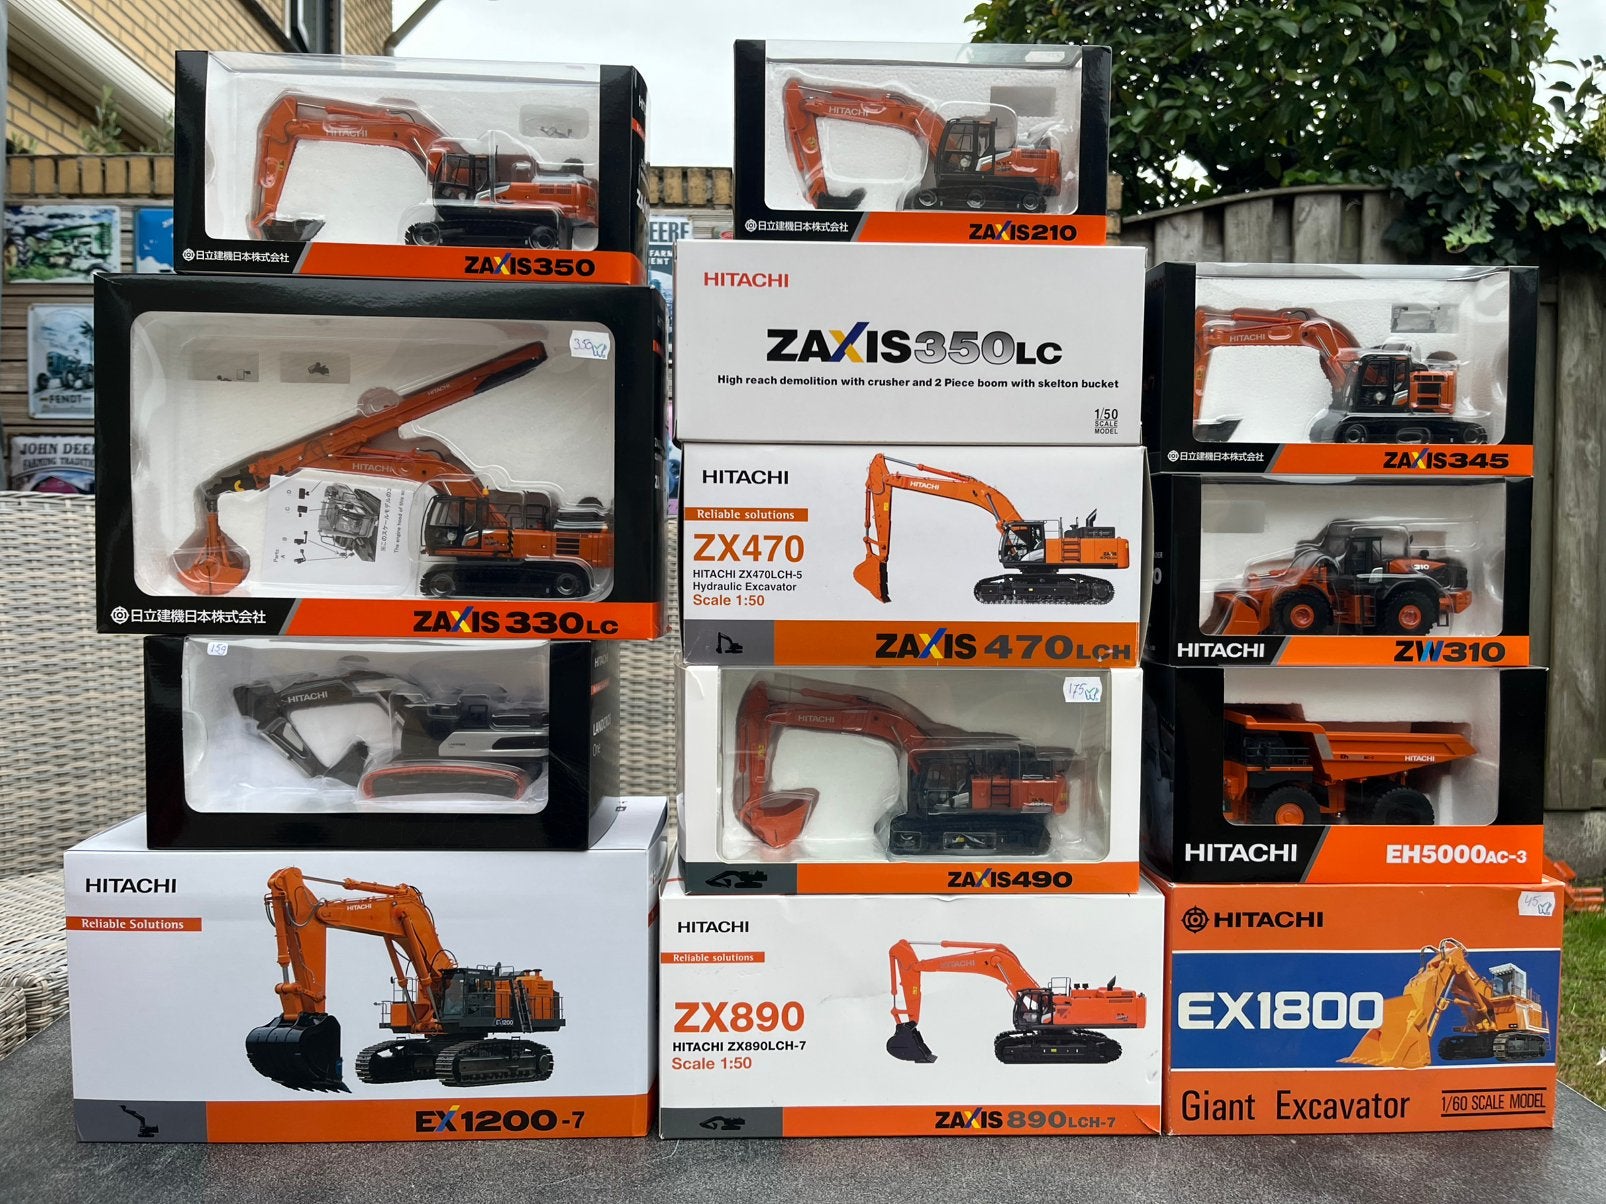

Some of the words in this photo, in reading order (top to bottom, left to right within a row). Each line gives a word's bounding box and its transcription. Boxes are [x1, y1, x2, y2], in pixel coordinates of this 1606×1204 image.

[829, 105, 870, 117] HITACHI
[649, 221, 690, 243] EERE
[758, 220, 849, 233] 日立建機日本株式会社
[968, 220, 1077, 242] ZAXIS210
[195, 250, 290, 263] 日立建機日本株式会社
[464, 252, 595, 278] ZAXIS350
[704, 272, 789, 288] HITACHI
[1229, 333, 1266, 343] HITACHI
[717, 374, 743, 386] High
[745, 375, 778, 385] reach
[779, 376, 838, 386] demolition
[841, 377, 865, 386] with
[867, 377, 910, 387] crusher
[912, 378, 932, 387] and
[934, 378, 942, 387] 2
[944, 378, 975, 387] Piece
[977, 378, 1008, 388] boom
[1011, 379, 1035, 388] with
[1038, 379, 1078, 389] skelton
[1081, 379, 1119, 389] bucket
[48, 394, 82, 404] FENDT
[1094, 407, 1119, 420] 1/50
[19, 442, 58, 455] JOHN
[1180, 451, 1265, 462] 日立建機日本株式会社
[1383, 448, 1510, 470] ZAXIS345
[352, 462, 393, 473] HITACHI
[702, 469, 789, 485] HITACHI
[909, 480, 940, 490] HITACHI
[696, 508, 741, 520] Reliable
[744, 509, 795, 520] solutions
[693, 533, 805, 563] ZX470
[692, 569, 736, 579] HITACHI
[738, 570, 803, 580] ZX470LCH-5
[692, 581, 743, 592] Hydraulic
[745, 582, 797, 592] Excavator
[693, 594, 732, 606] Scale
[736, 594, 765, 606] 1:50
[131, 608, 267, 624] 日立建機日本株式会社
[413, 605, 499, 634] ZAXIS
[506, 612, 619, 635] 330LC
[875, 627, 977, 659] ZAXIS
[984, 634, 1131, 660] 470LCH
[1177, 642, 1265, 658] HITACHI
[1394, 640, 1506, 663] ZW310
[287, 690, 329, 705] HITACHI
[797, 715, 835, 723] HITACHI
[1185, 843, 1297, 863] HITACHI
[1386, 844, 1527, 865] EH5000AC-3
[85, 877, 178, 894] HITACHI
[947, 868, 1073, 889] ZAXIS490
[346, 903, 372, 911] HITACHI
[1524, 894, 1542, 907] 45
[81, 918, 124, 931] Reliable
[126, 918, 184, 931] Solutions
[677, 920, 750, 933] HITACHI
[1214, 911, 1324, 928] HITACHI
[673, 953, 710, 962] Reliable
[712, 953, 754, 962] solutions
[673, 1001, 805, 1033] ZX890
[1178, 990, 1383, 1030] EX1800
[672, 1041, 724, 1052] HITACHI
[727, 1040, 807, 1051] ZX890LCH-7
[671, 1057, 715, 1070] Scale
[720, 1056, 752, 1070] 1:50
[1181, 1089, 1256, 1122] Giant
[1276, 1089, 1410, 1121] Excavator
[1441, 1094, 1468, 1113] 1/60
[1471, 1093, 1505, 1111] SCALE
[1509, 1092, 1546, 1109] MODEL
[415, 1105, 584, 1133] EX1200-7
